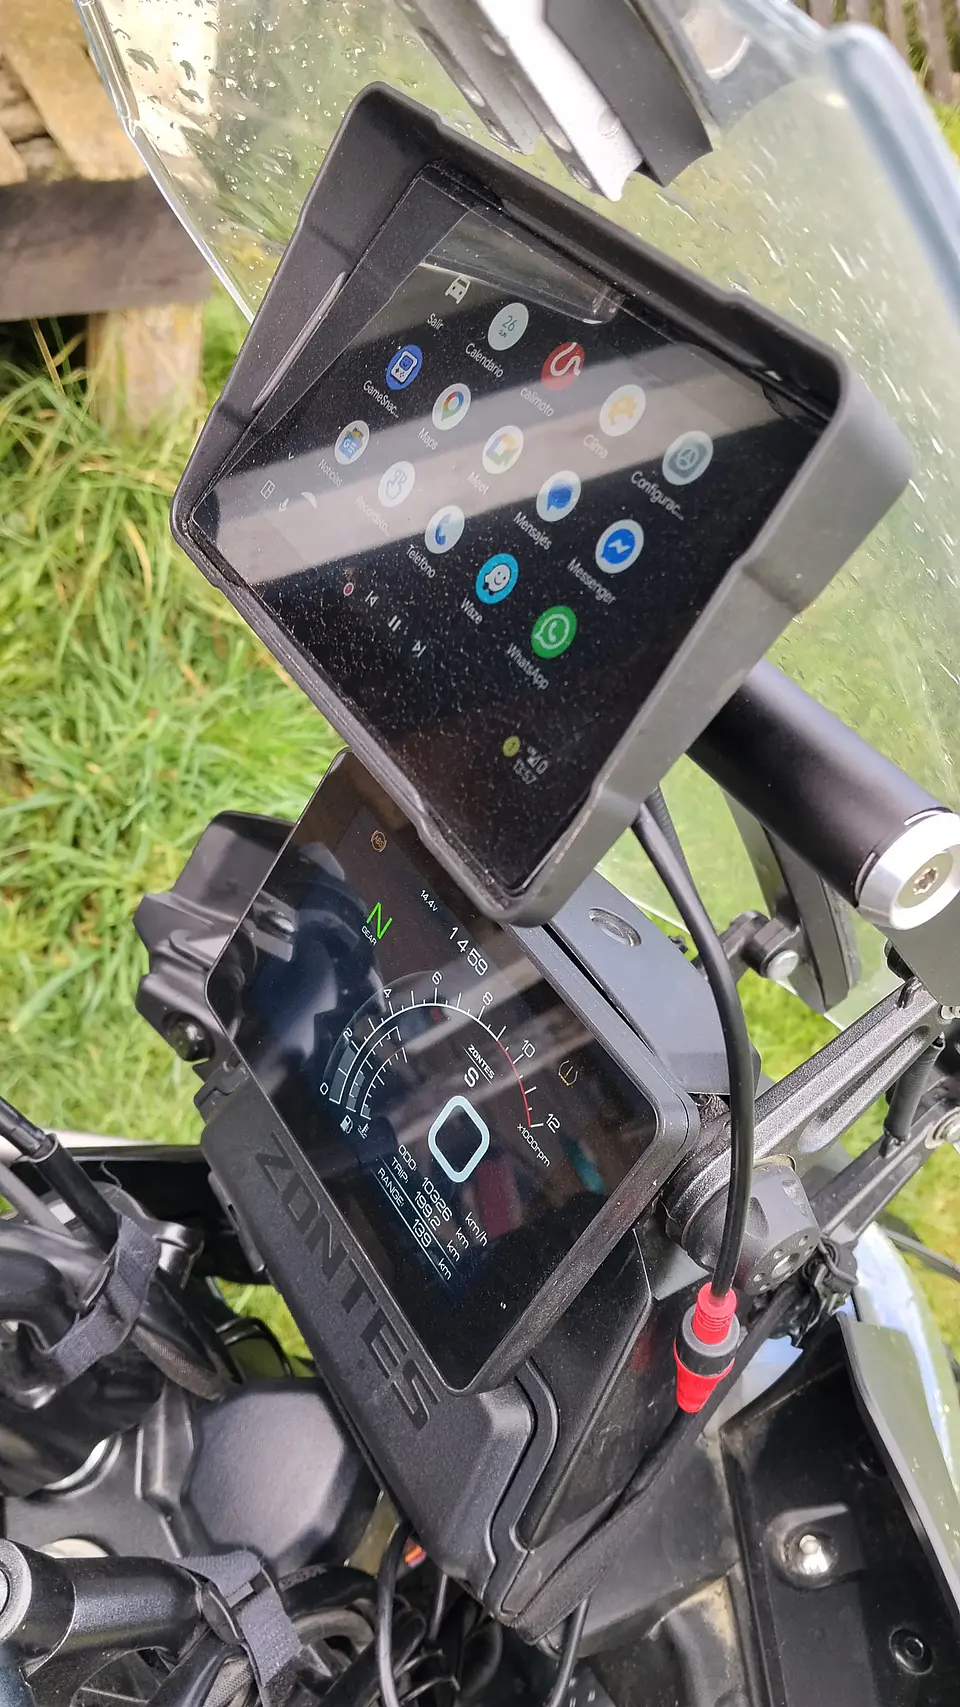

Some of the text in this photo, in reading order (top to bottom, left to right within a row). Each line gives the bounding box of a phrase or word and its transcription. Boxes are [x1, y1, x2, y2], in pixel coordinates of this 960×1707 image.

[427, 313, 444, 330] Salir
[502, 315, 516, 331] 26
[465, 342, 504, 378] Calendario
[363, 380, 399, 419] GameSnac...
[520, 387, 554, 417] calimoto
[418, 428, 438, 450] Maps
[583, 434, 608, 459] Clima
[318, 458, 343, 487] Noticias
[467, 472, 489, 494] Meet
[631, 471, 685, 520] Configurac...
[513, 511, 552, 550] Mensajes
[406, 544, 435, 579] Teléfono
[567, 556, 617, 605] Messenger
[460, 597, 483, 624] Waze
[507, 643, 549, 690] WhatsApp
[513, 758, 537, 785] 13:57
[361, 925, 377, 946] GEAR
[366, 902, 393, 940] N
[432, 971, 442, 985] 6
[383, 988, 392, 998] 4
[482, 991, 494, 1006] 8
[343, 1027, 353, 1041] 2
[521, 1039, 536, 1058] 10
[467, 1044, 495, 1080] ZONTES
[319, 1082, 329, 1095] 0
[464, 1066, 479, 1088] S
[546, 1113, 561, 1133] 12
[517, 1123, 551, 1167] x1000rpm
[414, 1191, 441, 1231] 199.2
[446, 1239, 461, 1262] km
[422, 1177, 453, 1222] 10326
[455, 1227, 470, 1249] km
[465, 1211, 488, 1247] km/h
[412, 1218, 432, 1248] 139
[438, 1258, 452, 1280] km
[256, 1130, 441, 1431] ZONTES
